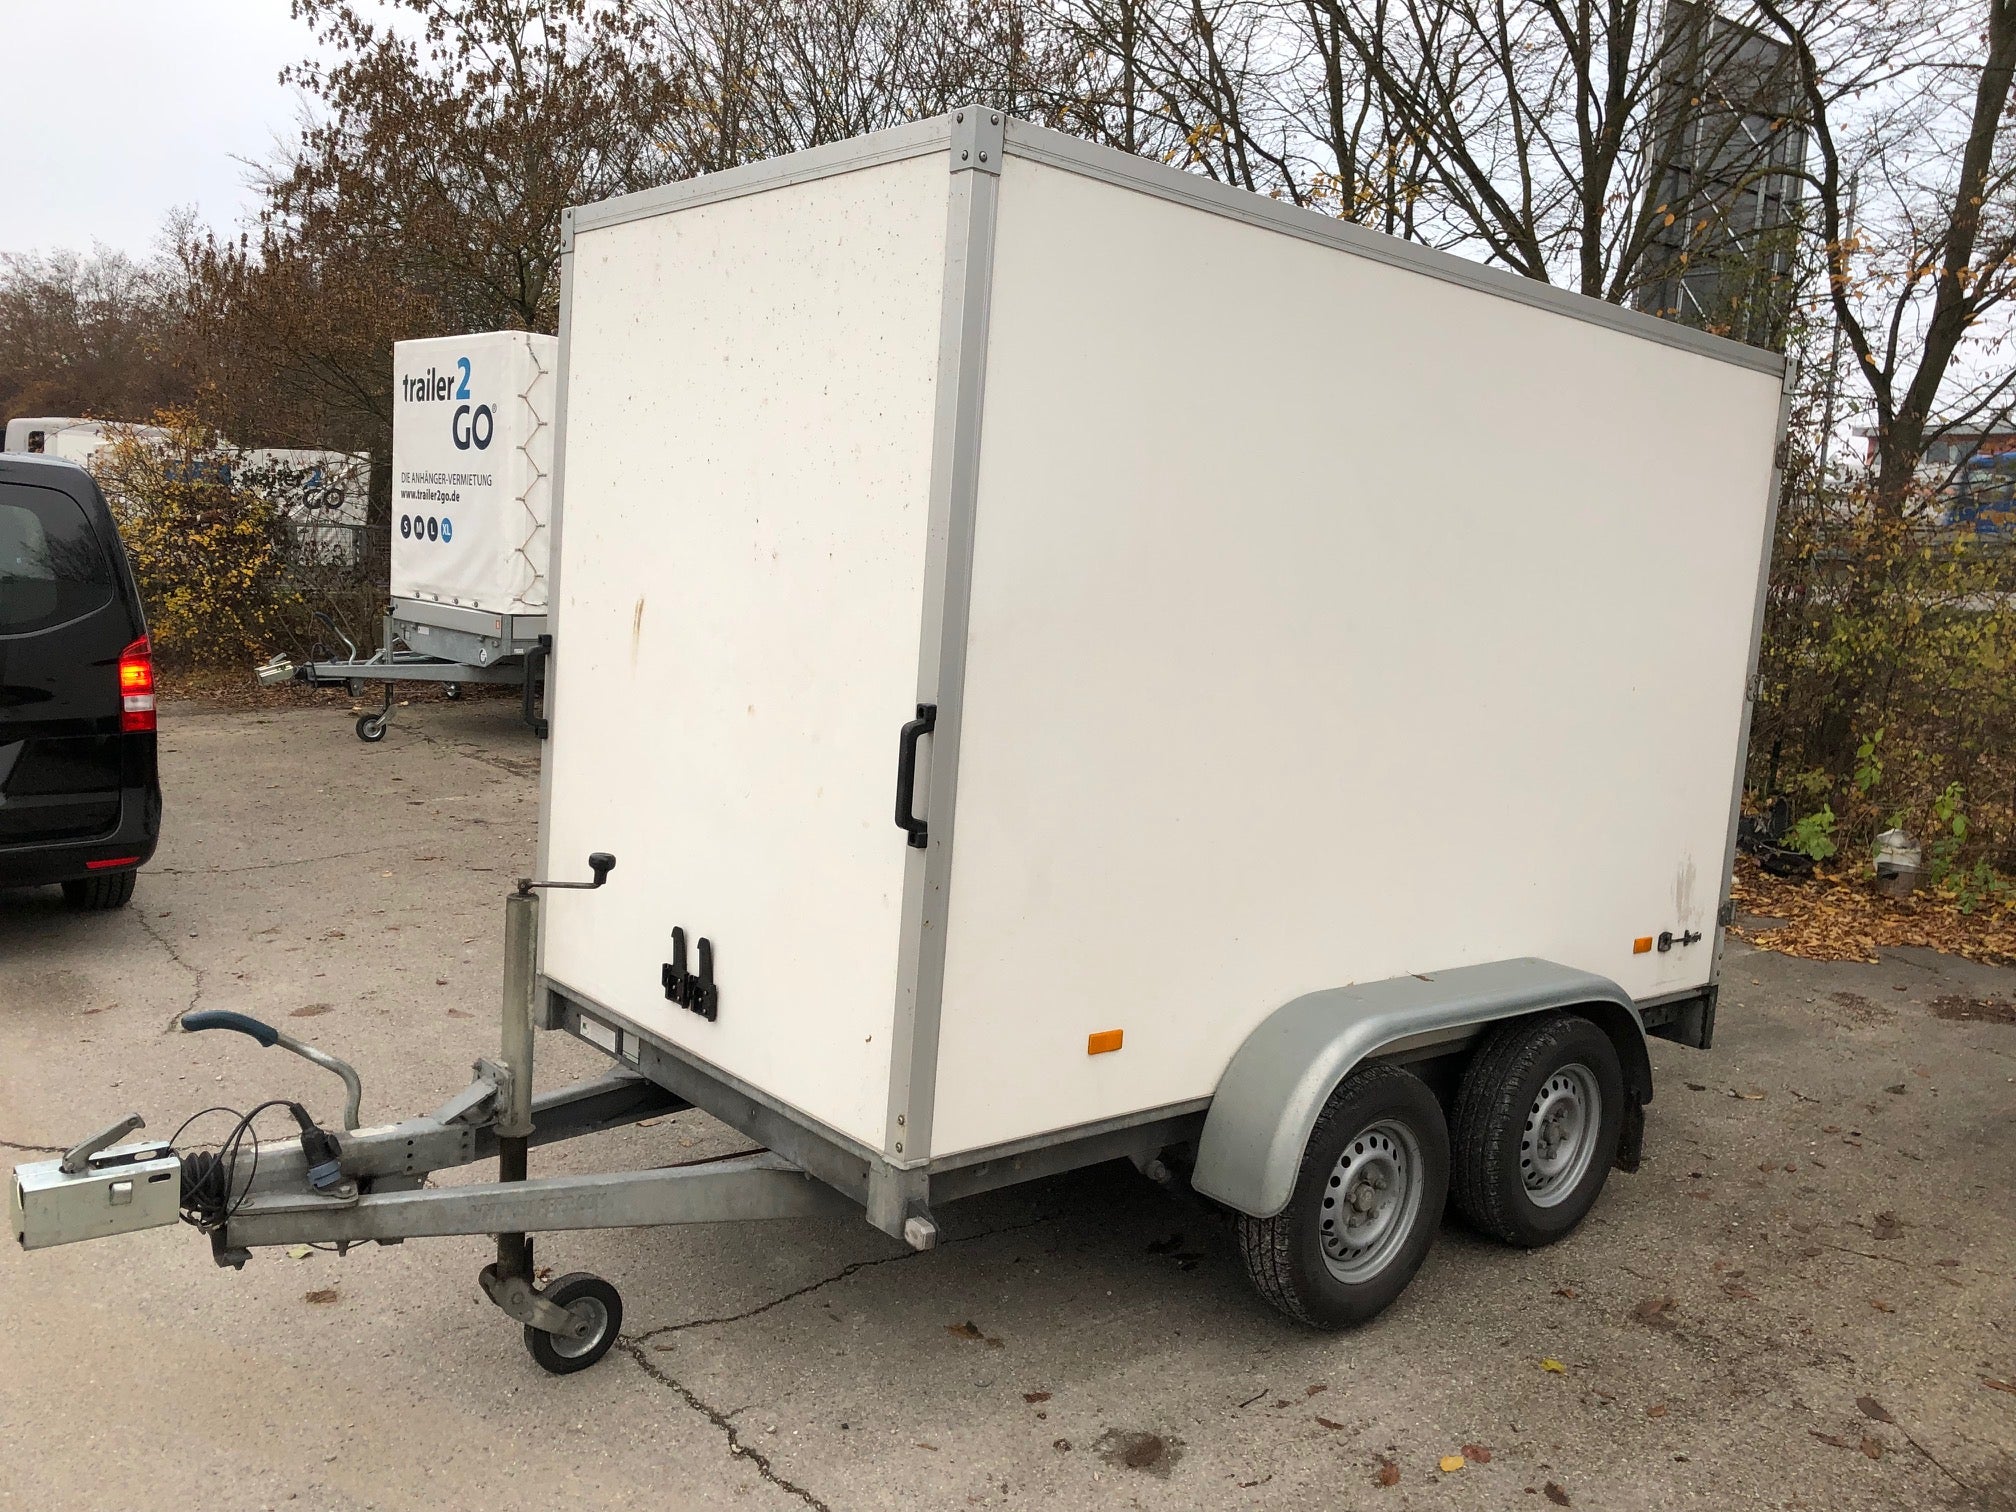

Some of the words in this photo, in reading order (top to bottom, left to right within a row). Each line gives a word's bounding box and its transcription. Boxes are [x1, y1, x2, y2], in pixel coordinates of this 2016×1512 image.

[401, 472, 410, 483] DIE
[411, 470, 492, 486] ANHÄNGER-VERMIETUNG
[400, 489, 460, 504] www.trailer2go.de
